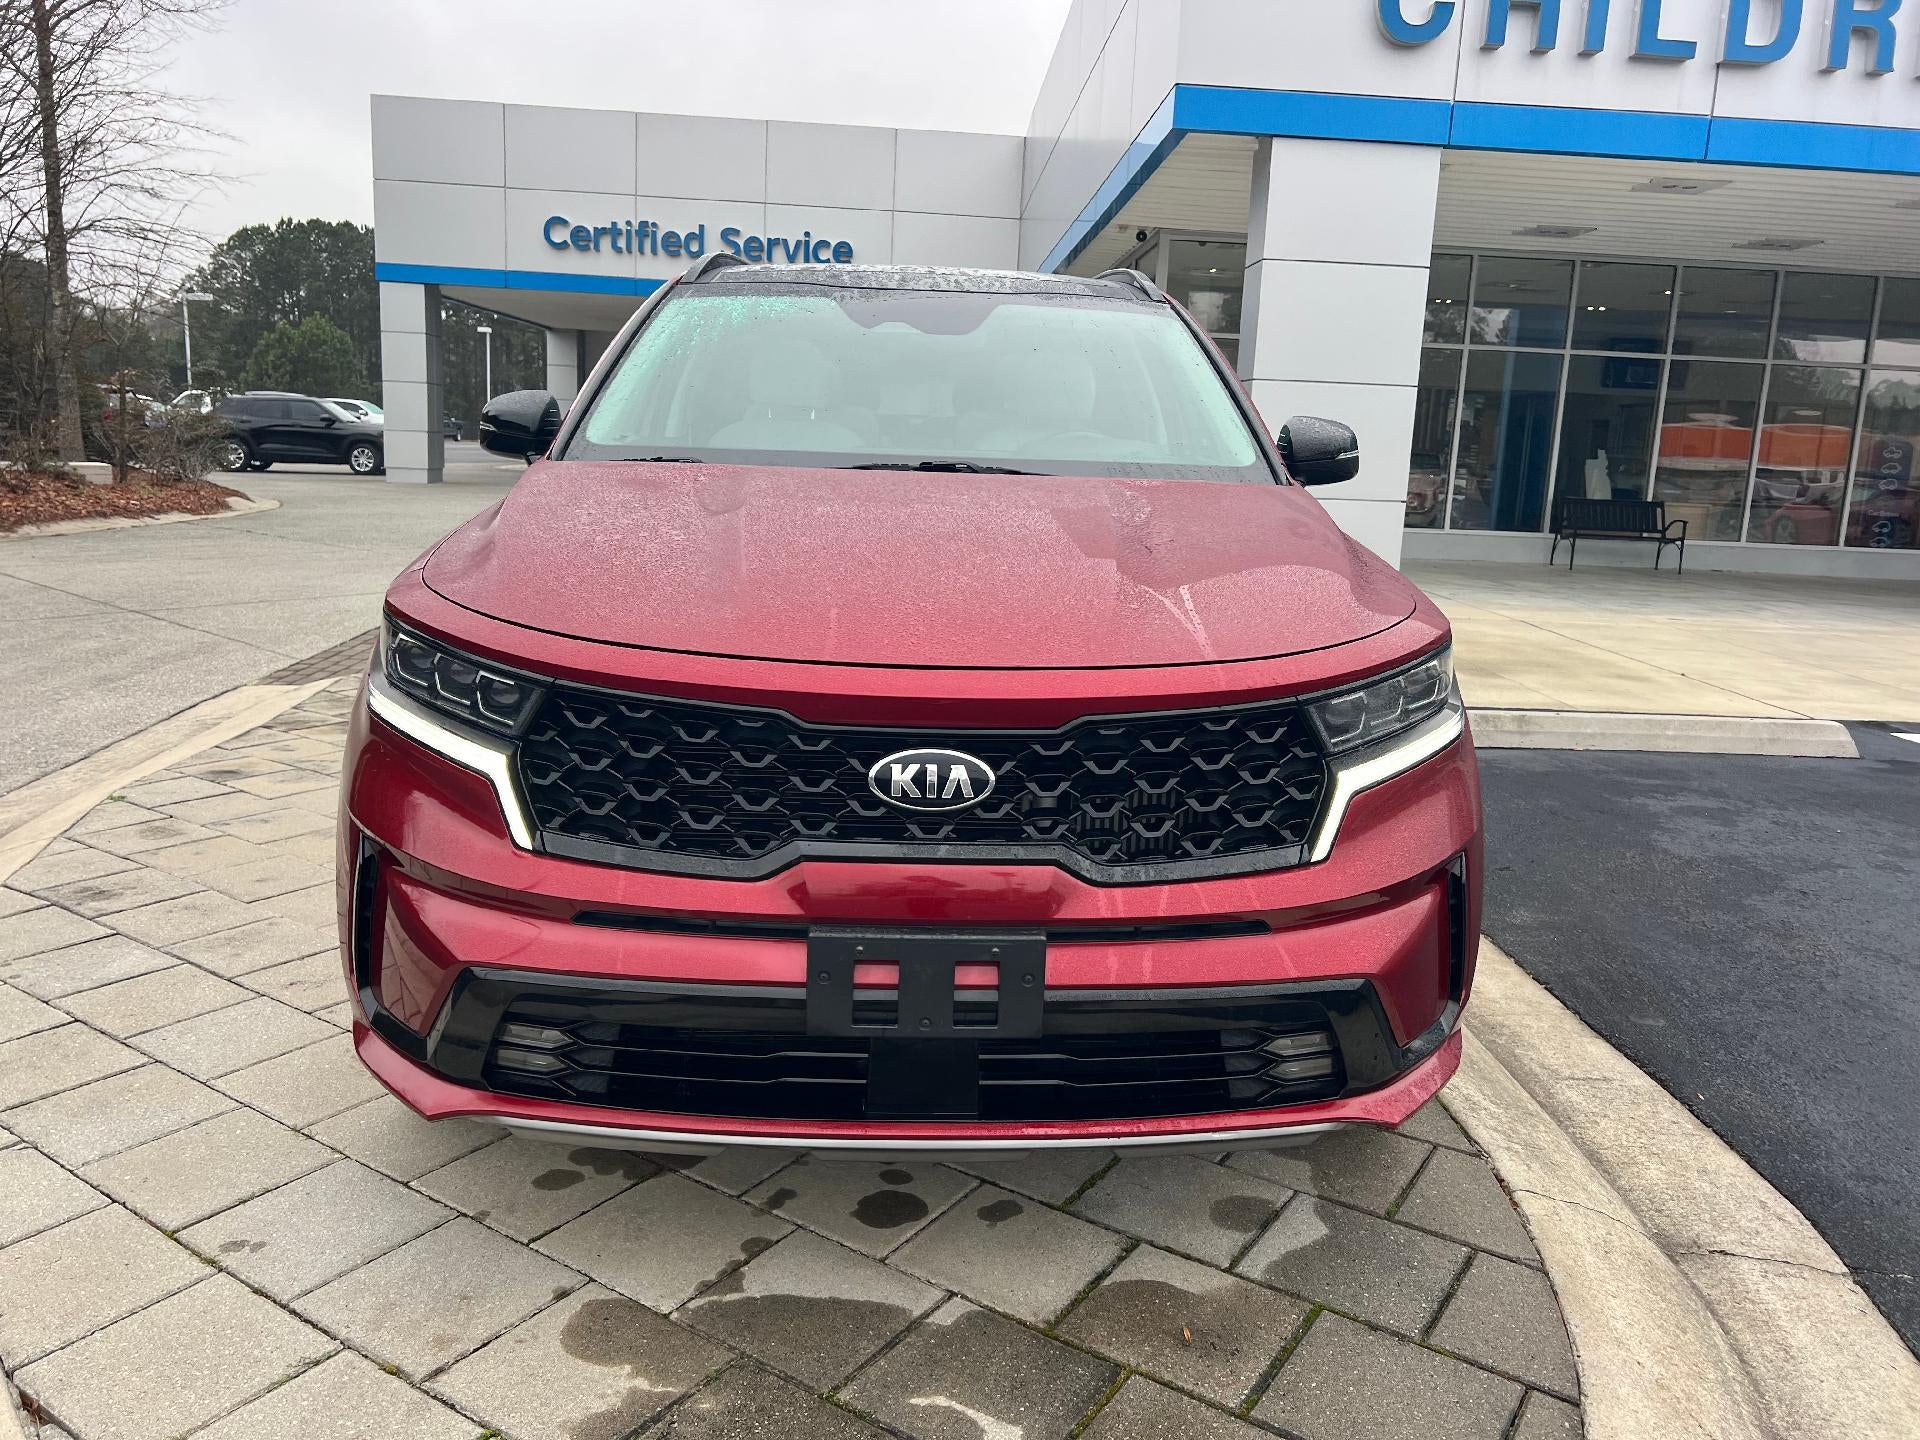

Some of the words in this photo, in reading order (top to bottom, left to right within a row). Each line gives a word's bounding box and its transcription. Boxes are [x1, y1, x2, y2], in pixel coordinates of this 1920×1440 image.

[543, 215, 705, 258] Certified
[719, 227, 854, 263] Service
[889, 763, 975, 798] KIA
